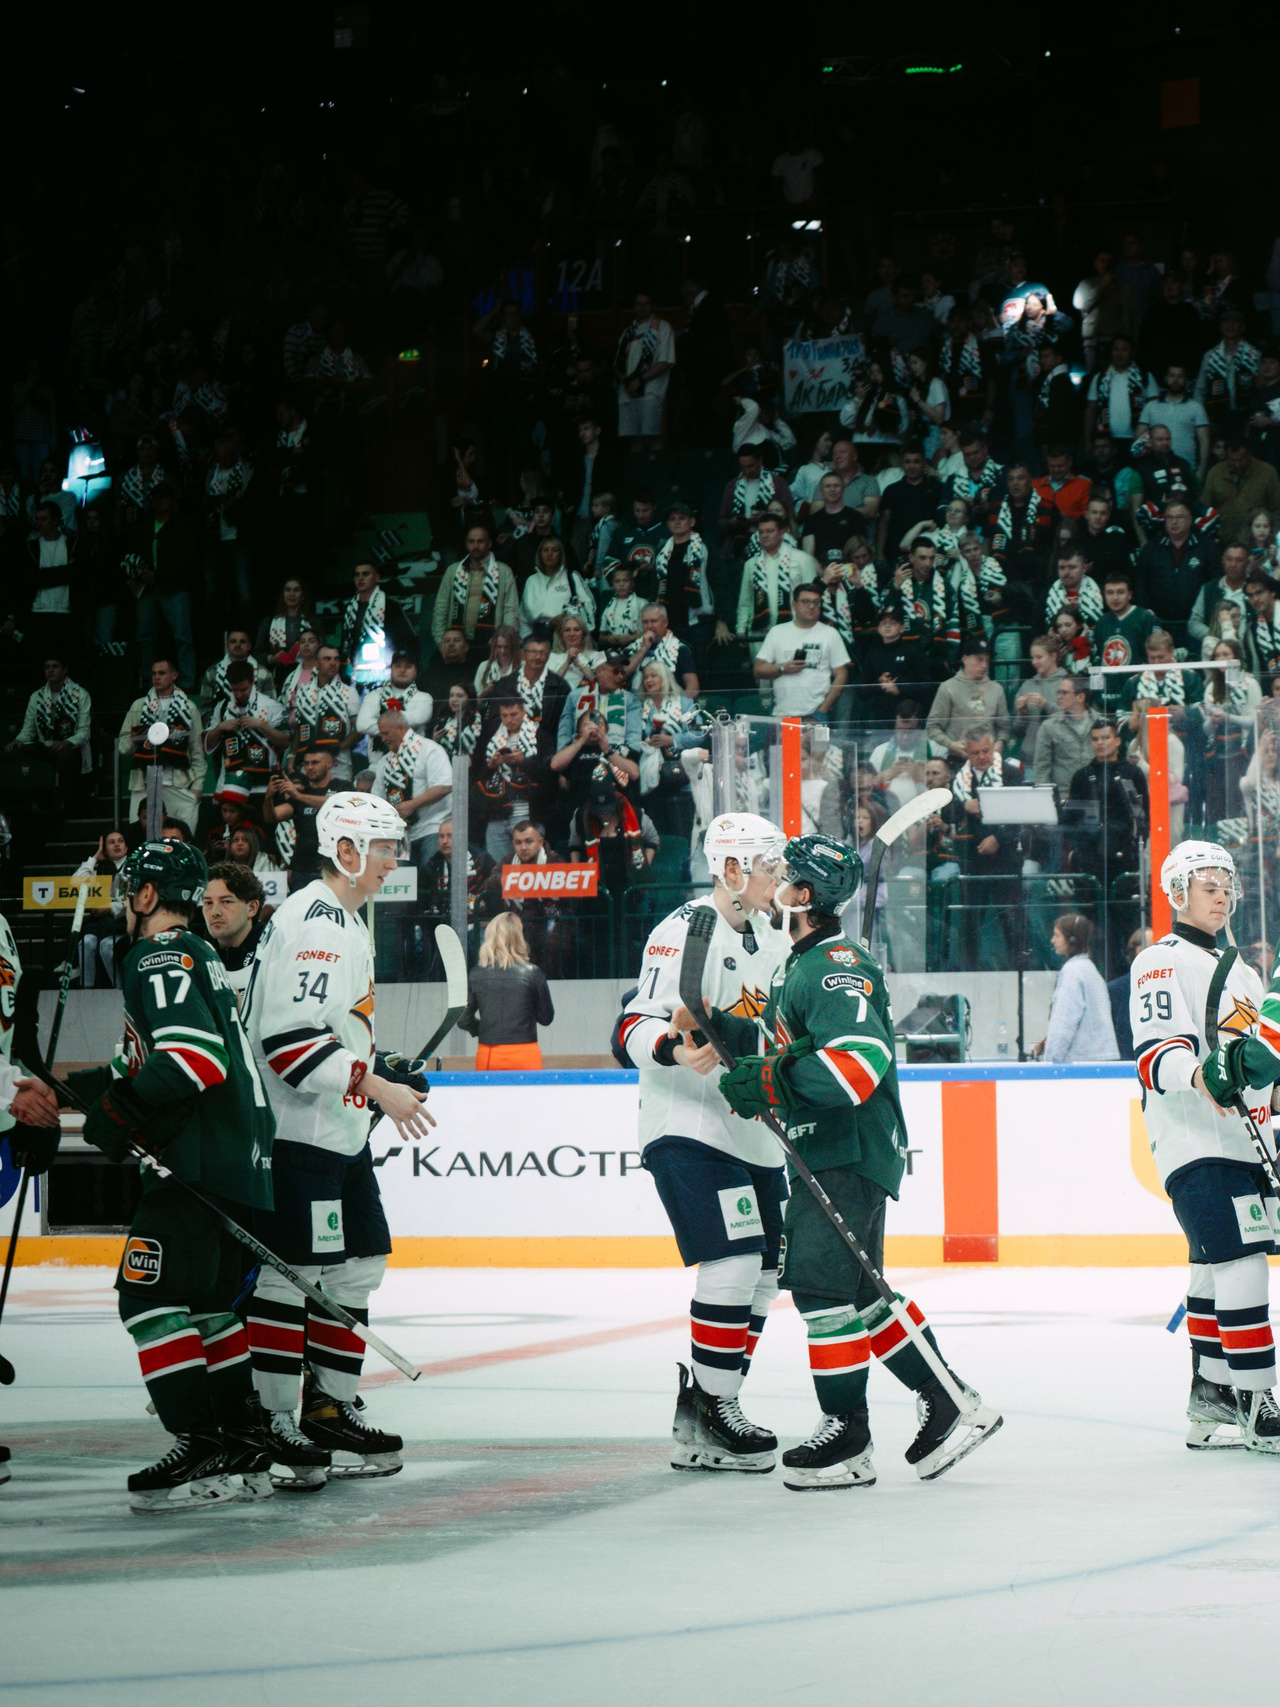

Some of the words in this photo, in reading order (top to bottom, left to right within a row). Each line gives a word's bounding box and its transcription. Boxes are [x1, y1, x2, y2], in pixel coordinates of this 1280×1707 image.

[338, 817, 362, 826] FONBET
[504, 871, 595, 891] FONBET
[142, 953, 180, 968] Winline
[296, 950, 341, 964] FONBET
[646, 946, 680, 958] ONBET
[293, 971, 329, 1004] 34
[827, 976, 864, 989] Winline
[1137, 967, 1174, 989] FONBET
[149, 970, 192, 1010] 17
[844, 990, 868, 1023] 7
[1139, 990, 1173, 1023] 39
[1250, 1104, 1271, 1126] FON
[412, 1145, 646, 1178] КАМАСТР
[130, 1252, 158, 1270] Win
[234, 1228, 299, 1283] RIBCOR
[1219, 1402, 1237, 1414] BAU
